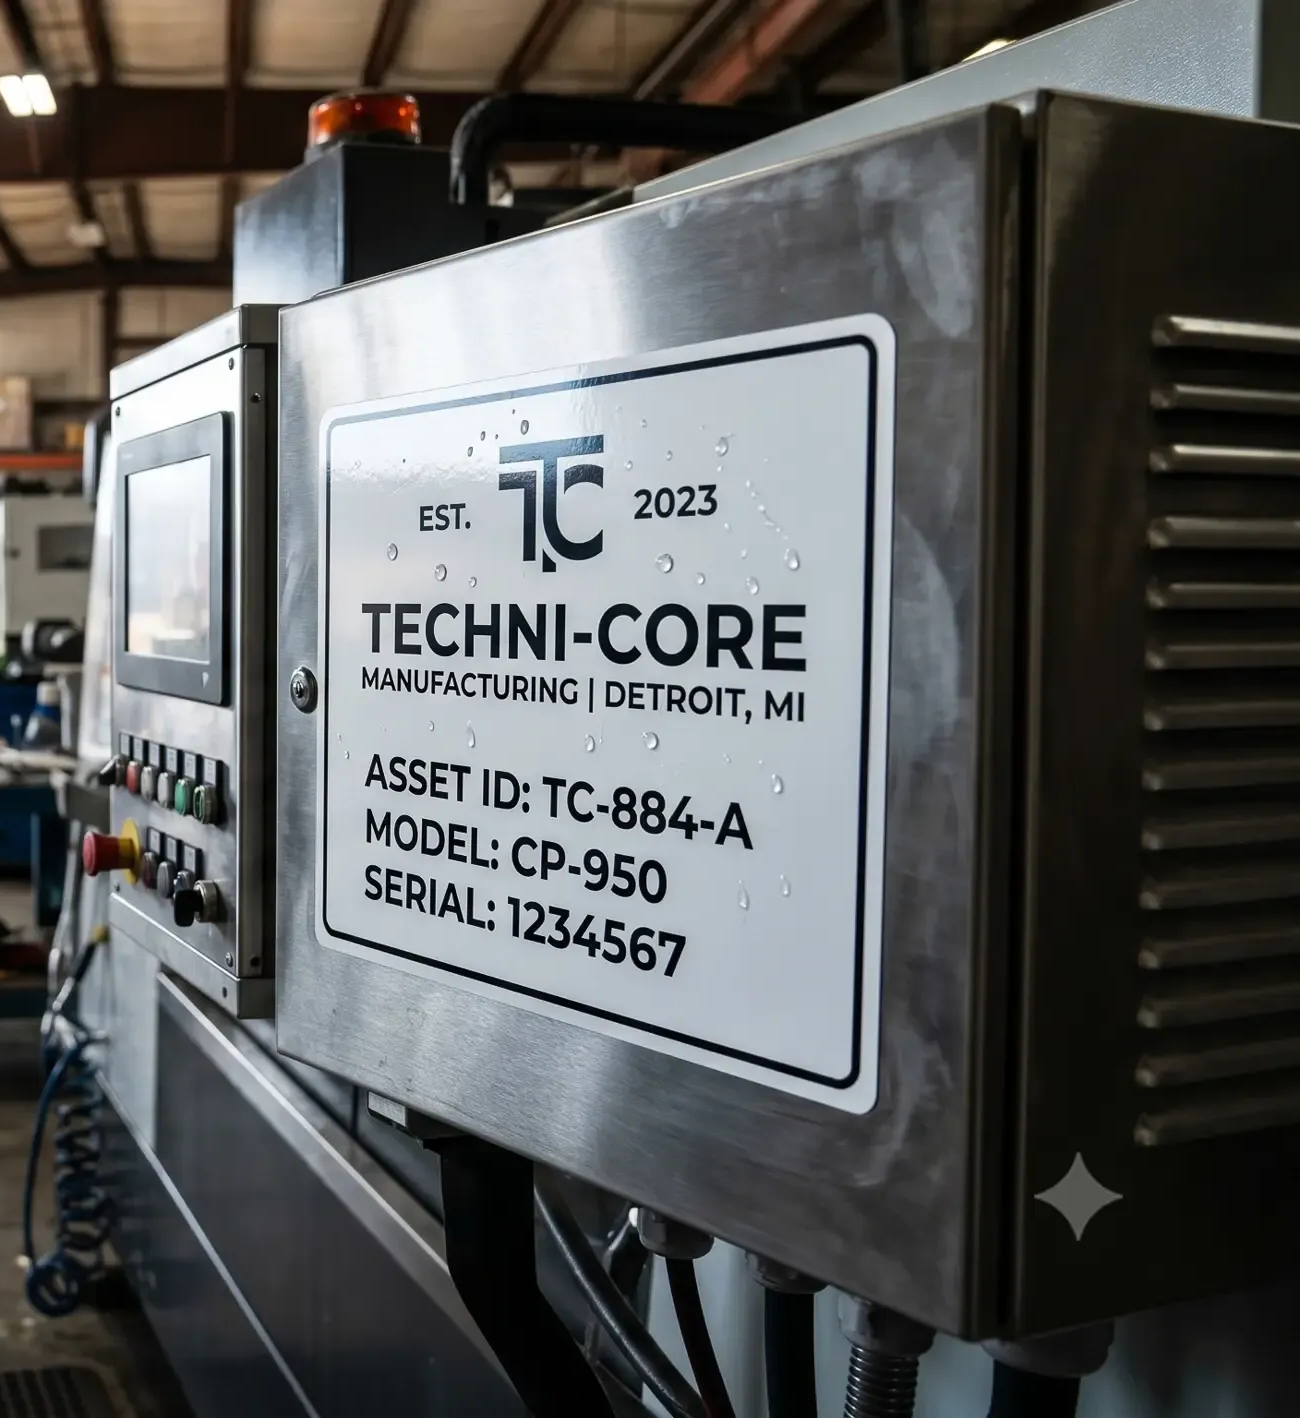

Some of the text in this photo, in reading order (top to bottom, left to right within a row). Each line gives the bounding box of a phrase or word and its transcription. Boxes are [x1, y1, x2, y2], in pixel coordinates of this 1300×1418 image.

[419, 484, 718, 532] EST. 2023
[361, 602, 807, 672] TECHNI-CORE
[361, 666, 579, 706] MANUFACTURING
[605, 680, 752, 725] DETROIT,
[764, 689, 805, 723] MI
[364, 753, 754, 851] ASSET ID: TC-884-A
[366, 808, 668, 905] MODEL: CP-950
[364, 864, 687, 978] SERIAL: 1234567
